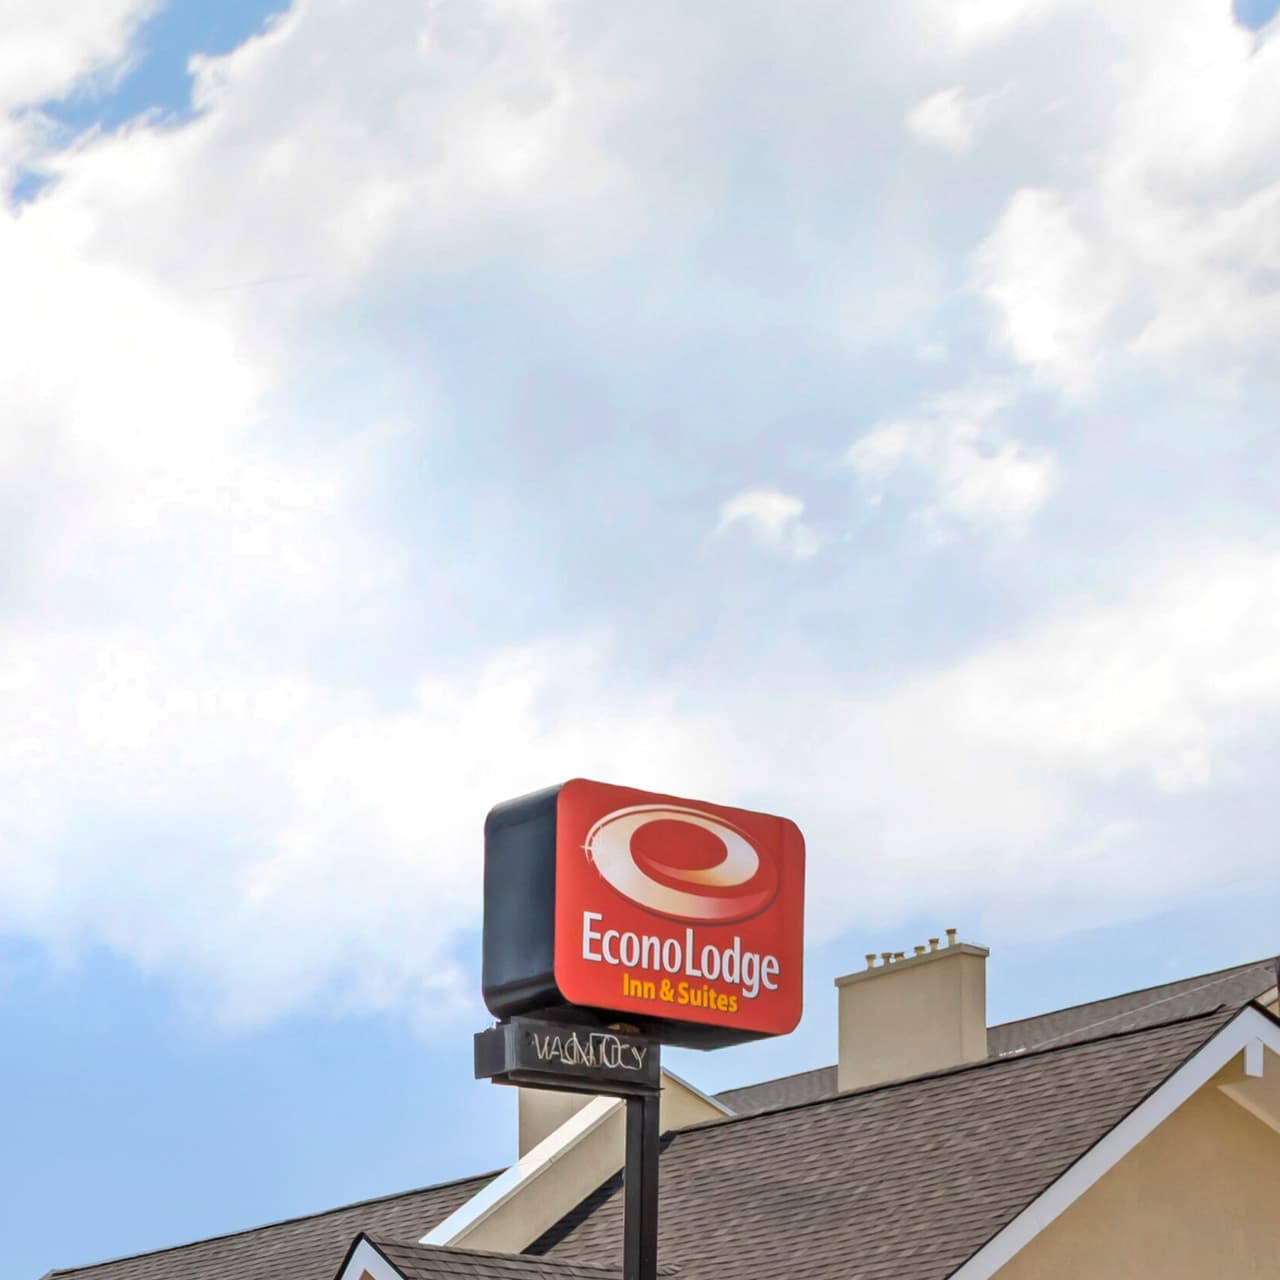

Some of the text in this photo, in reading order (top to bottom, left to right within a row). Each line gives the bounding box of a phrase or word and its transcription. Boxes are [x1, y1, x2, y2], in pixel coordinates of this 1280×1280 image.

[582, 911, 780, 999] EconoLodge
[623, 973, 738, 1012] Inn & Suites
